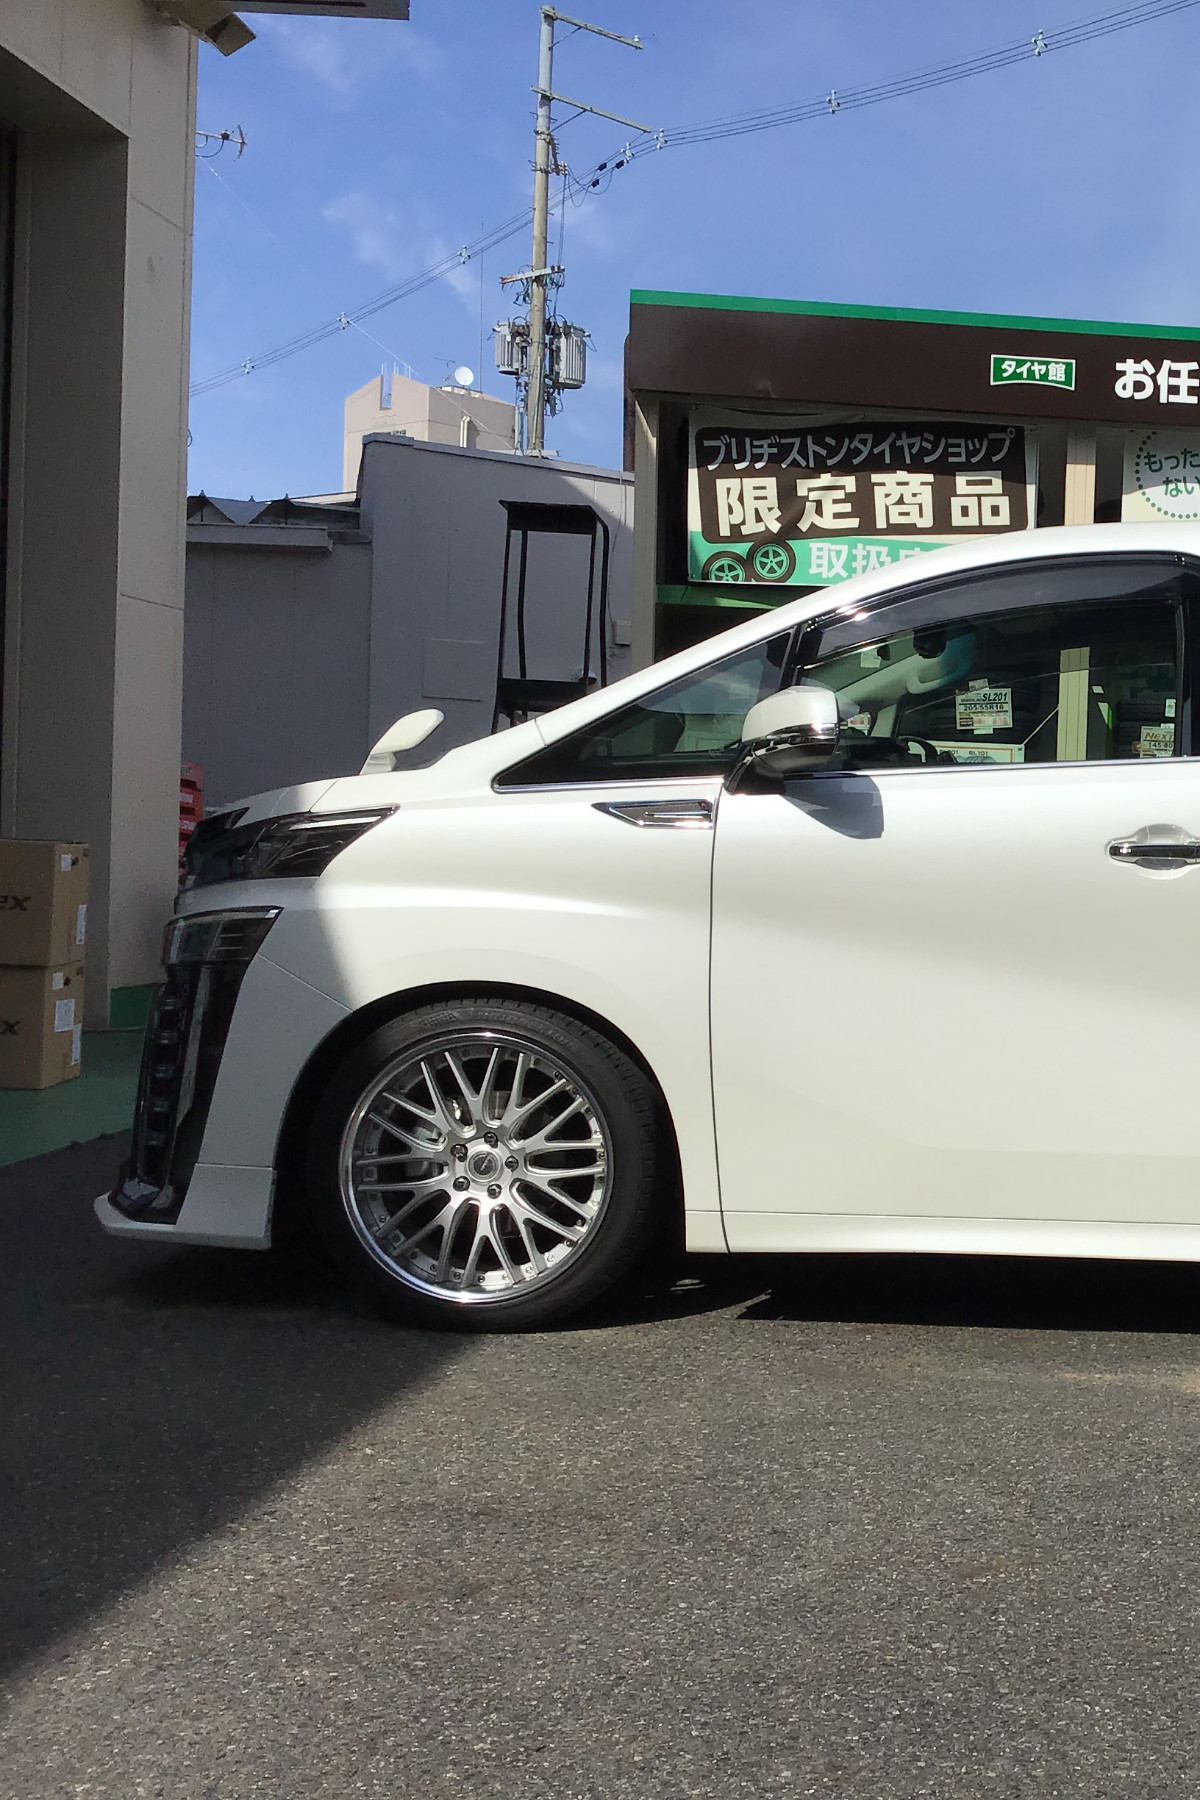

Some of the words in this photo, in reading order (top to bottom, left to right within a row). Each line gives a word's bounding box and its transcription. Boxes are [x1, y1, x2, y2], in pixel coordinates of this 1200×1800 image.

[1001, 360, 1066, 382] タイヤ館
[703, 427, 1016, 472] ブリヂストンタイヤショップ
[715, 470, 1010, 537] 限定商品
[808, 542, 927, 579] 取扱
[982, 692, 1008, 702] SL201
